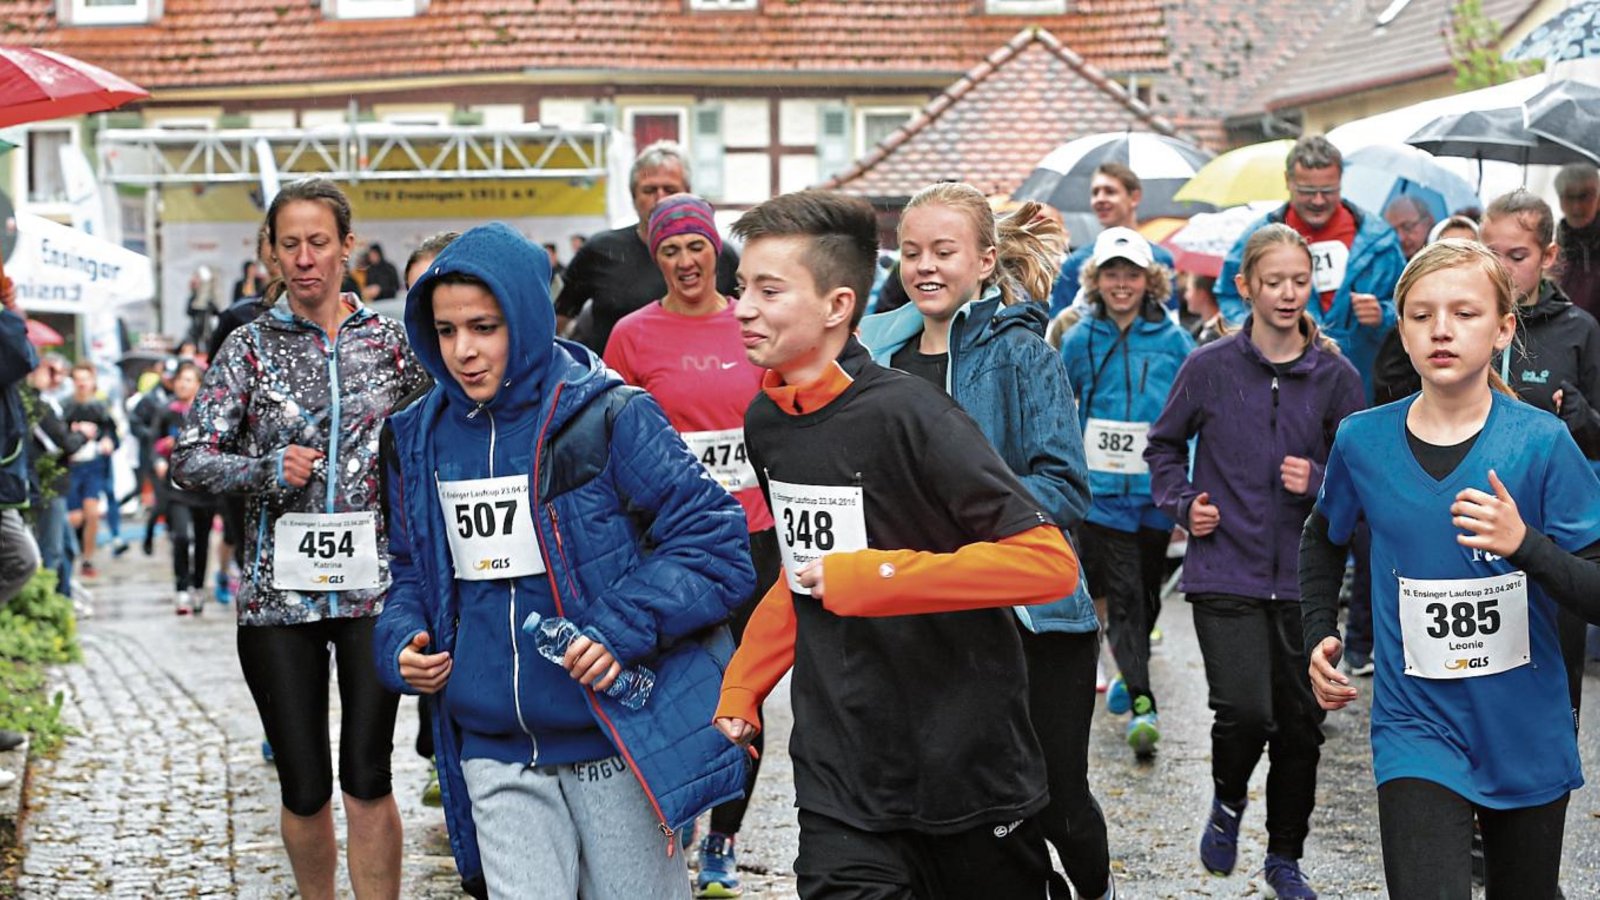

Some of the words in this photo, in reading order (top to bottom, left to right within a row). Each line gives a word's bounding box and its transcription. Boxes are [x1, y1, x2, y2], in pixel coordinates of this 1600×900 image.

[42, 238, 121, 282] Ensinger
[1312, 252, 1332, 271] 21
[1098, 431, 1134, 453] 382
[701, 442, 747, 467] 474
[501, 485, 528, 495] 23.04.2
[455, 499, 518, 540] 507
[783, 507, 835, 551] 348
[298, 530, 355, 559] 454
[313, 561, 343, 569] Katrina
[491, 557, 511, 570] GLS
[328, 575, 345, 584] GLS
[1413, 589, 1448, 600] Ensinger
[1449, 589, 1482, 599] Laufcup
[1484, 580, 1522, 596] 23.04.2016
[1425, 598, 1501, 639] 385
[1448, 640, 1484, 651] Leonie
[1468, 656, 1490, 669] GLS
